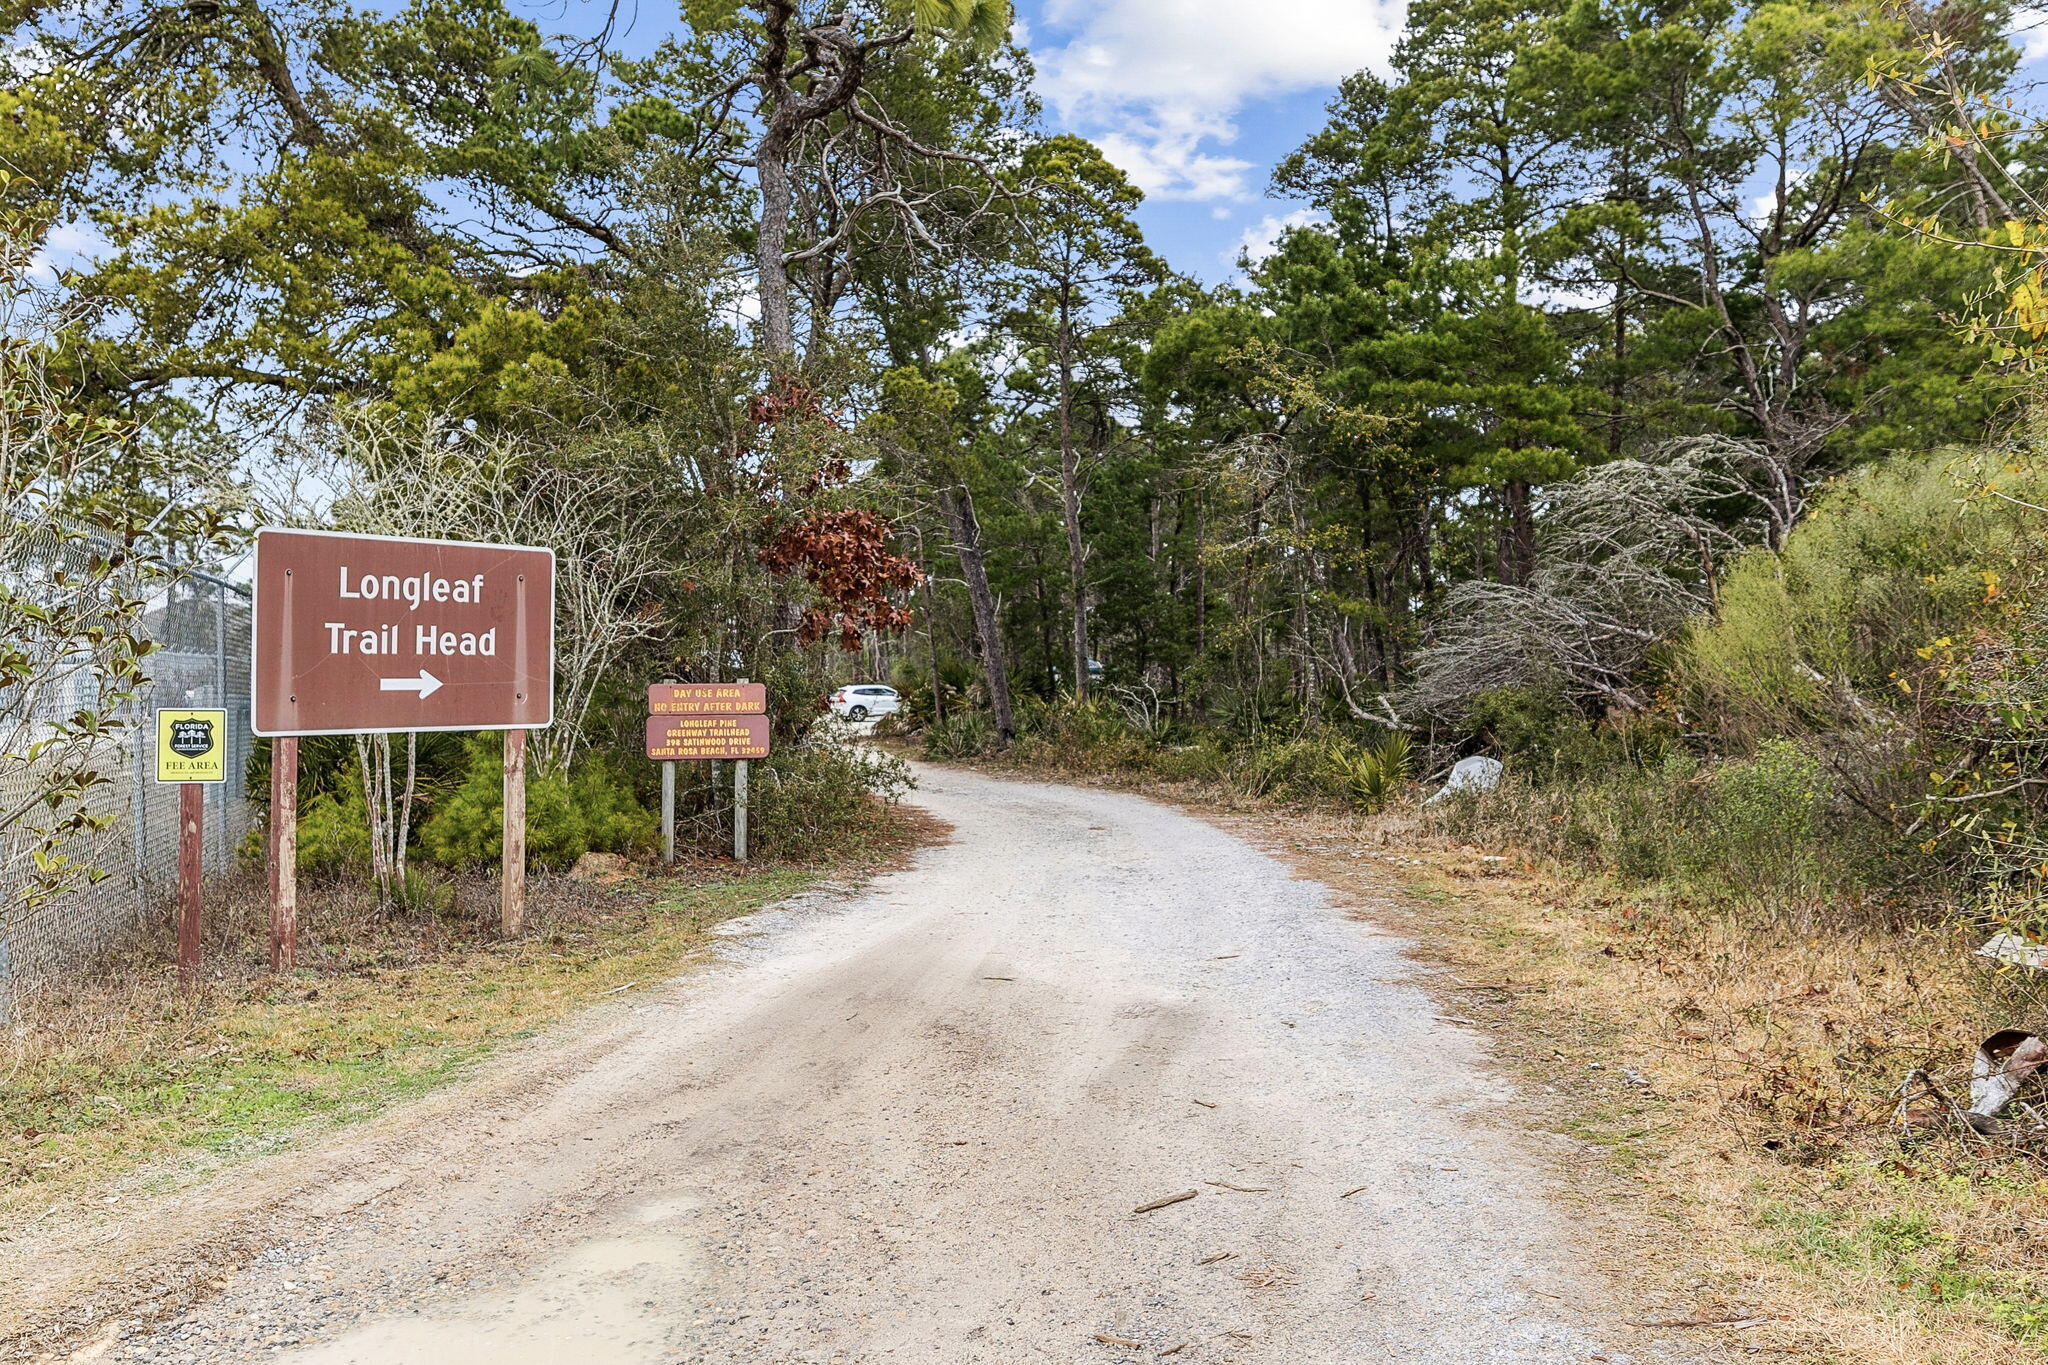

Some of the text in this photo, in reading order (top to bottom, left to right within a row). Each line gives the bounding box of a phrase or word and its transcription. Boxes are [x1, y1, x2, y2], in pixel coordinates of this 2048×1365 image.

[340, 566, 484, 610] Longleaf
[325, 622, 496, 656] Trail Head
[674, 689, 740, 698] DAY USE AREA
[654, 702, 760, 712] NO ENTRY AFTER DARK
[680, 720, 717, 728] LONGLEAF
[666, 728, 750, 737] GREENWAY TRAILHEAD
[684, 738, 726, 746] SATINWOOD
[729, 738, 750, 746] DRIVE
[166, 762, 218, 770] FEE AREA
